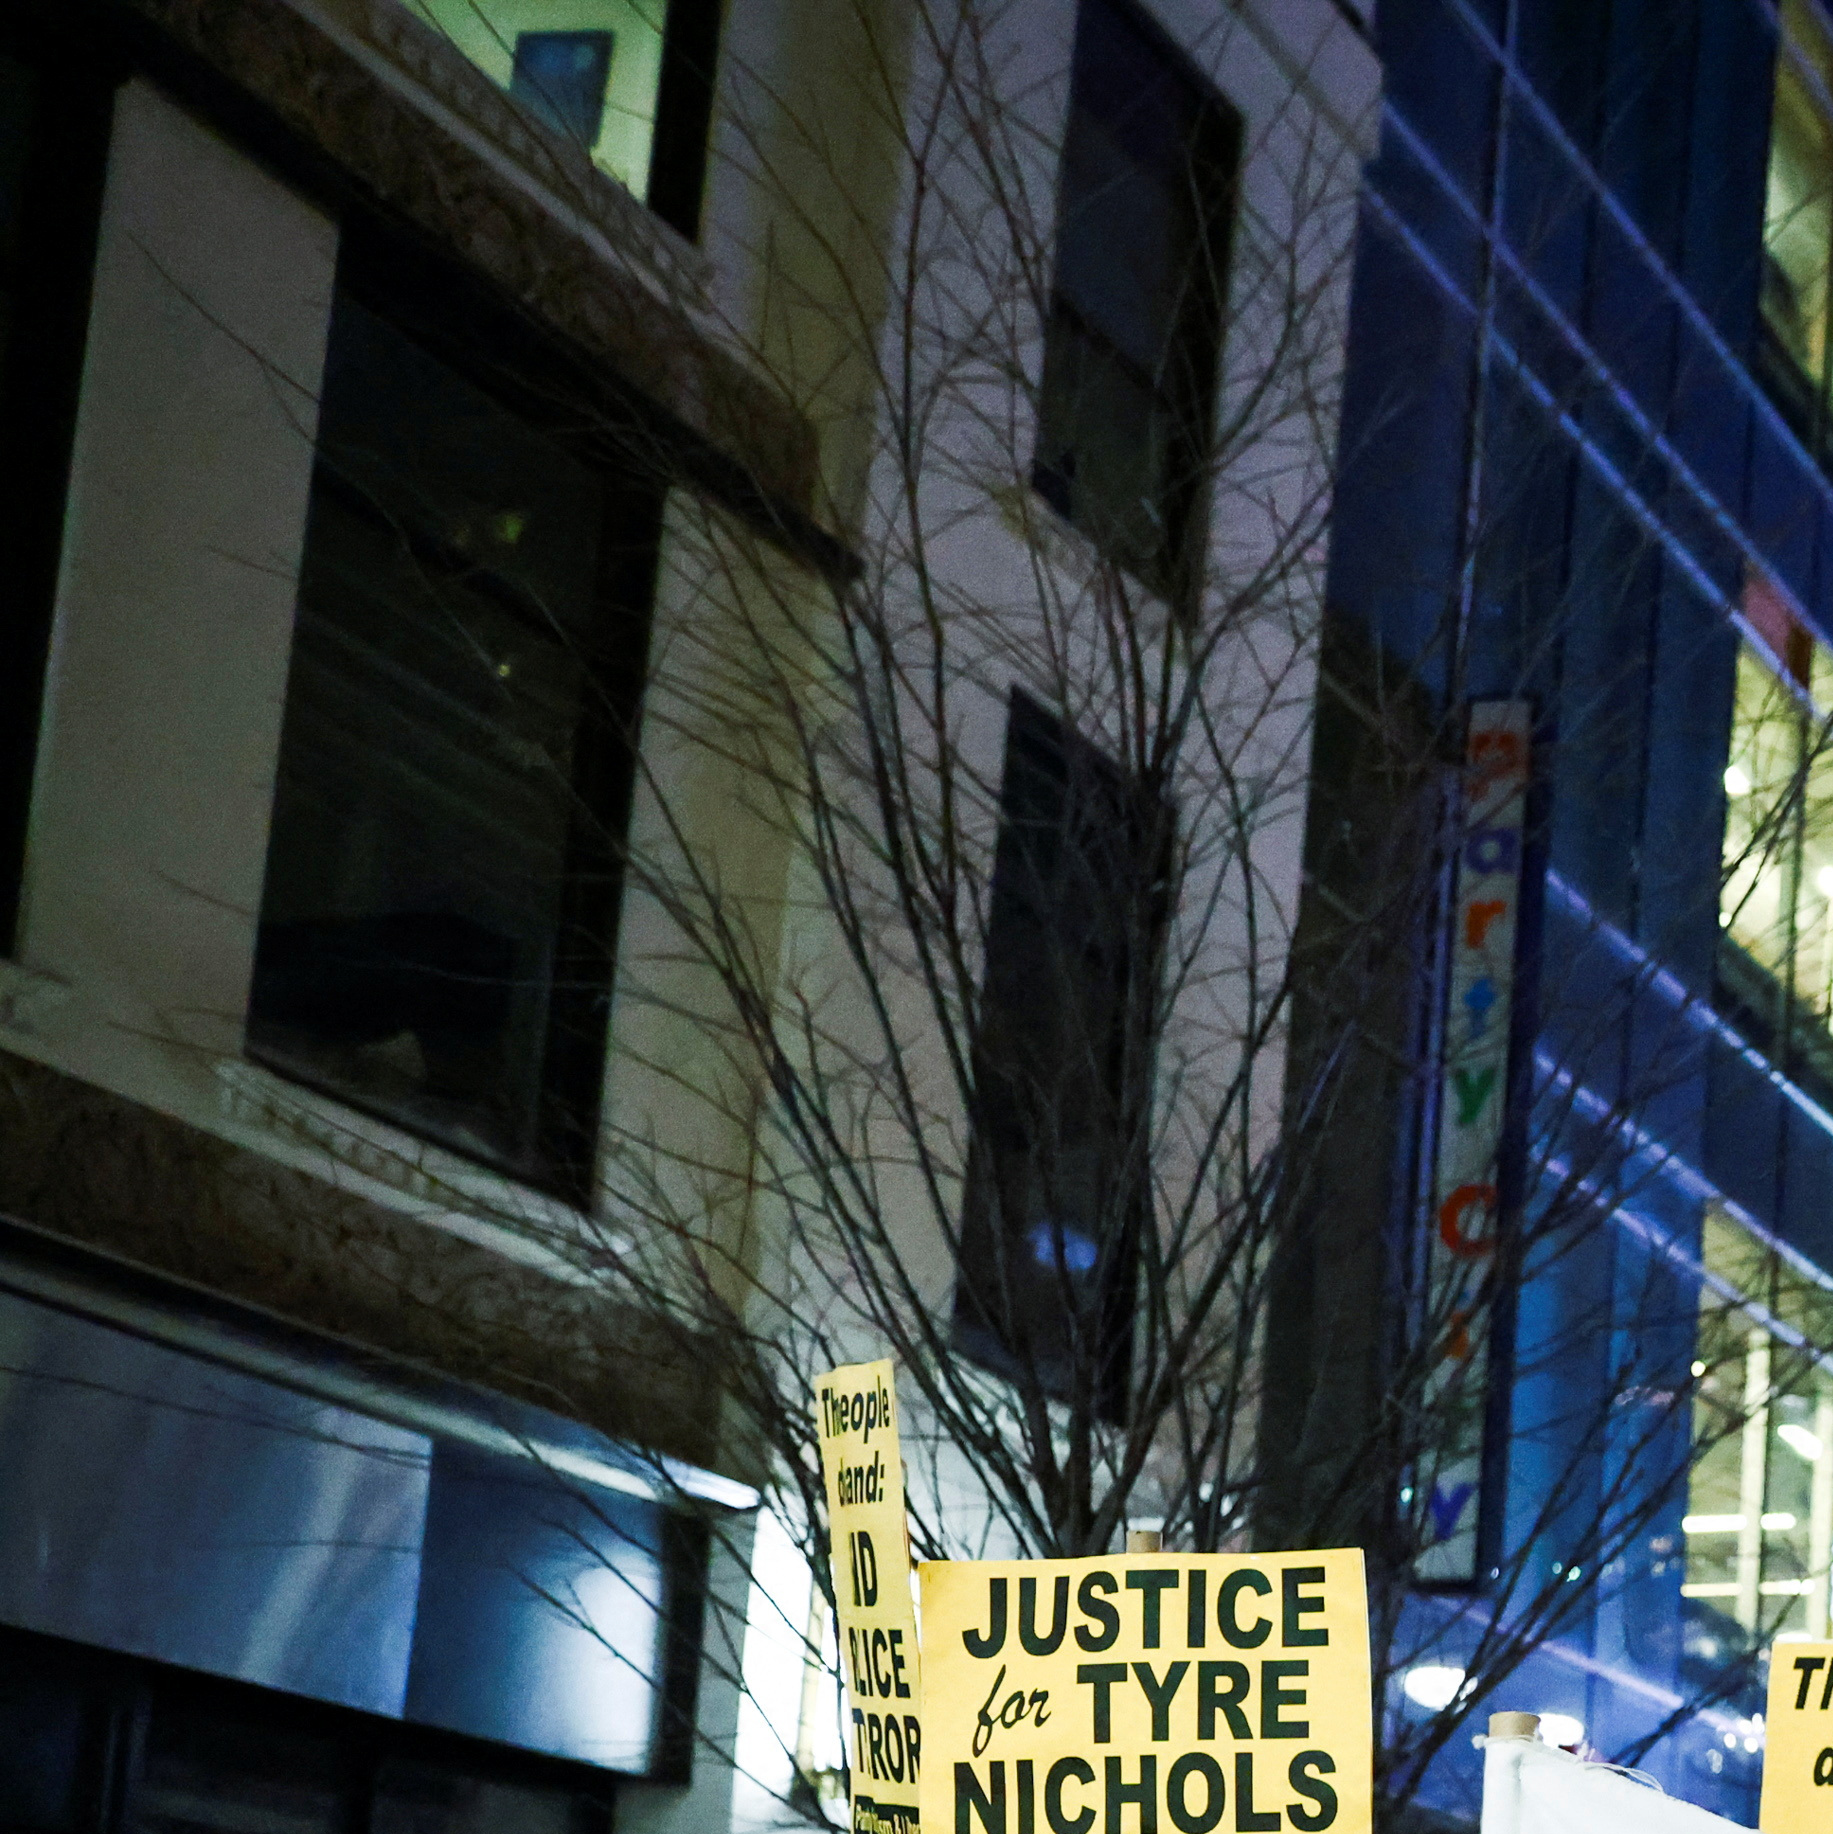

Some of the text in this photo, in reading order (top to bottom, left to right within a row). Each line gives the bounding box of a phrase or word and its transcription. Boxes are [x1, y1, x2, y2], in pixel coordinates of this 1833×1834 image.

[962, 1566, 1329, 1658] JUSTICE
[973, 1660, 1309, 1758] for TYRE
